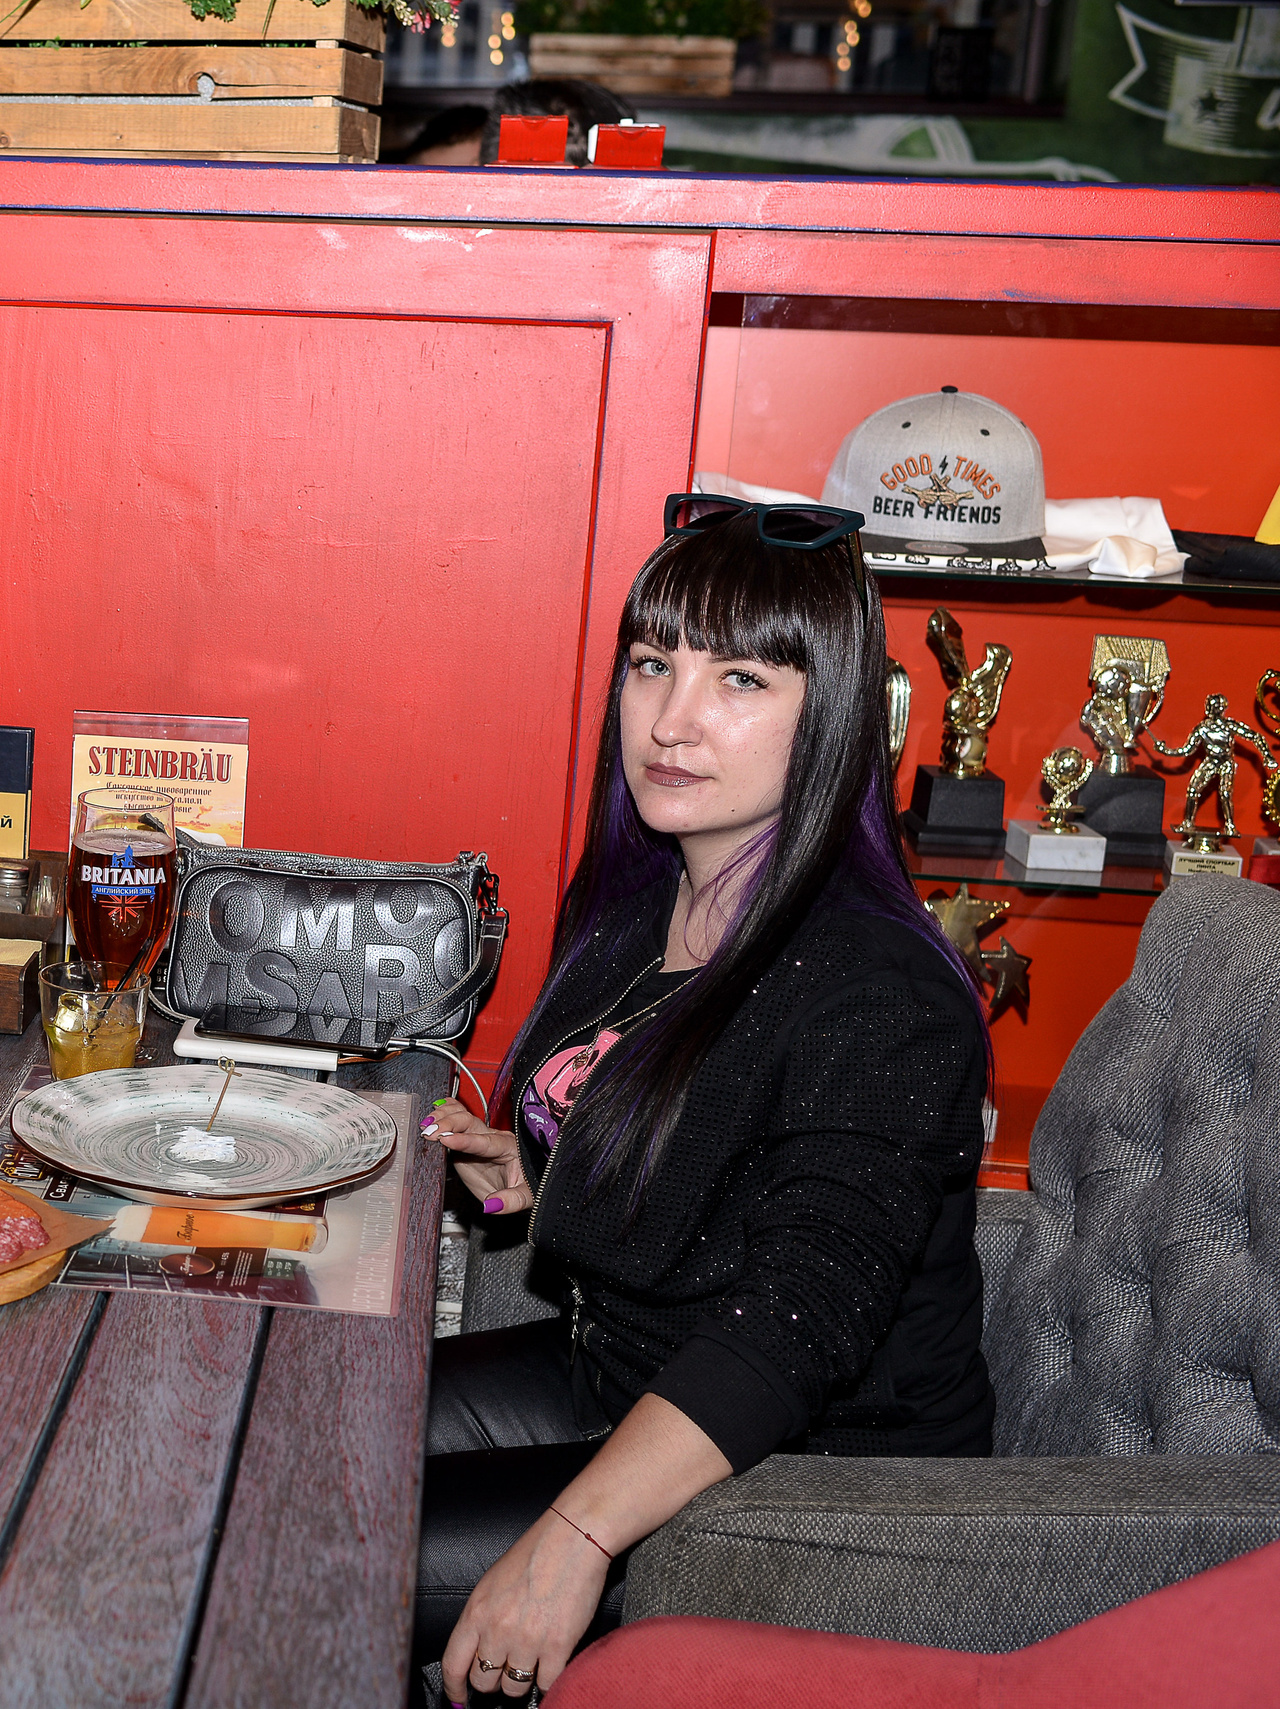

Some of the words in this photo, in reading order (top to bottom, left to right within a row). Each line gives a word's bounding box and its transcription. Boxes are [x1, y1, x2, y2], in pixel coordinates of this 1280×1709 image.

[880, 453, 932, 491] GOOD
[953, 455, 1001, 500] TIMES
[872, 496, 914, 518] BEER
[923, 503, 1001, 525] FRIENDS
[88, 745, 234, 783] STEINBRÄU
[81, 864, 166, 886] BRITANIA
[95, 887, 139, 895] АНГЛИЙСКИЙ
